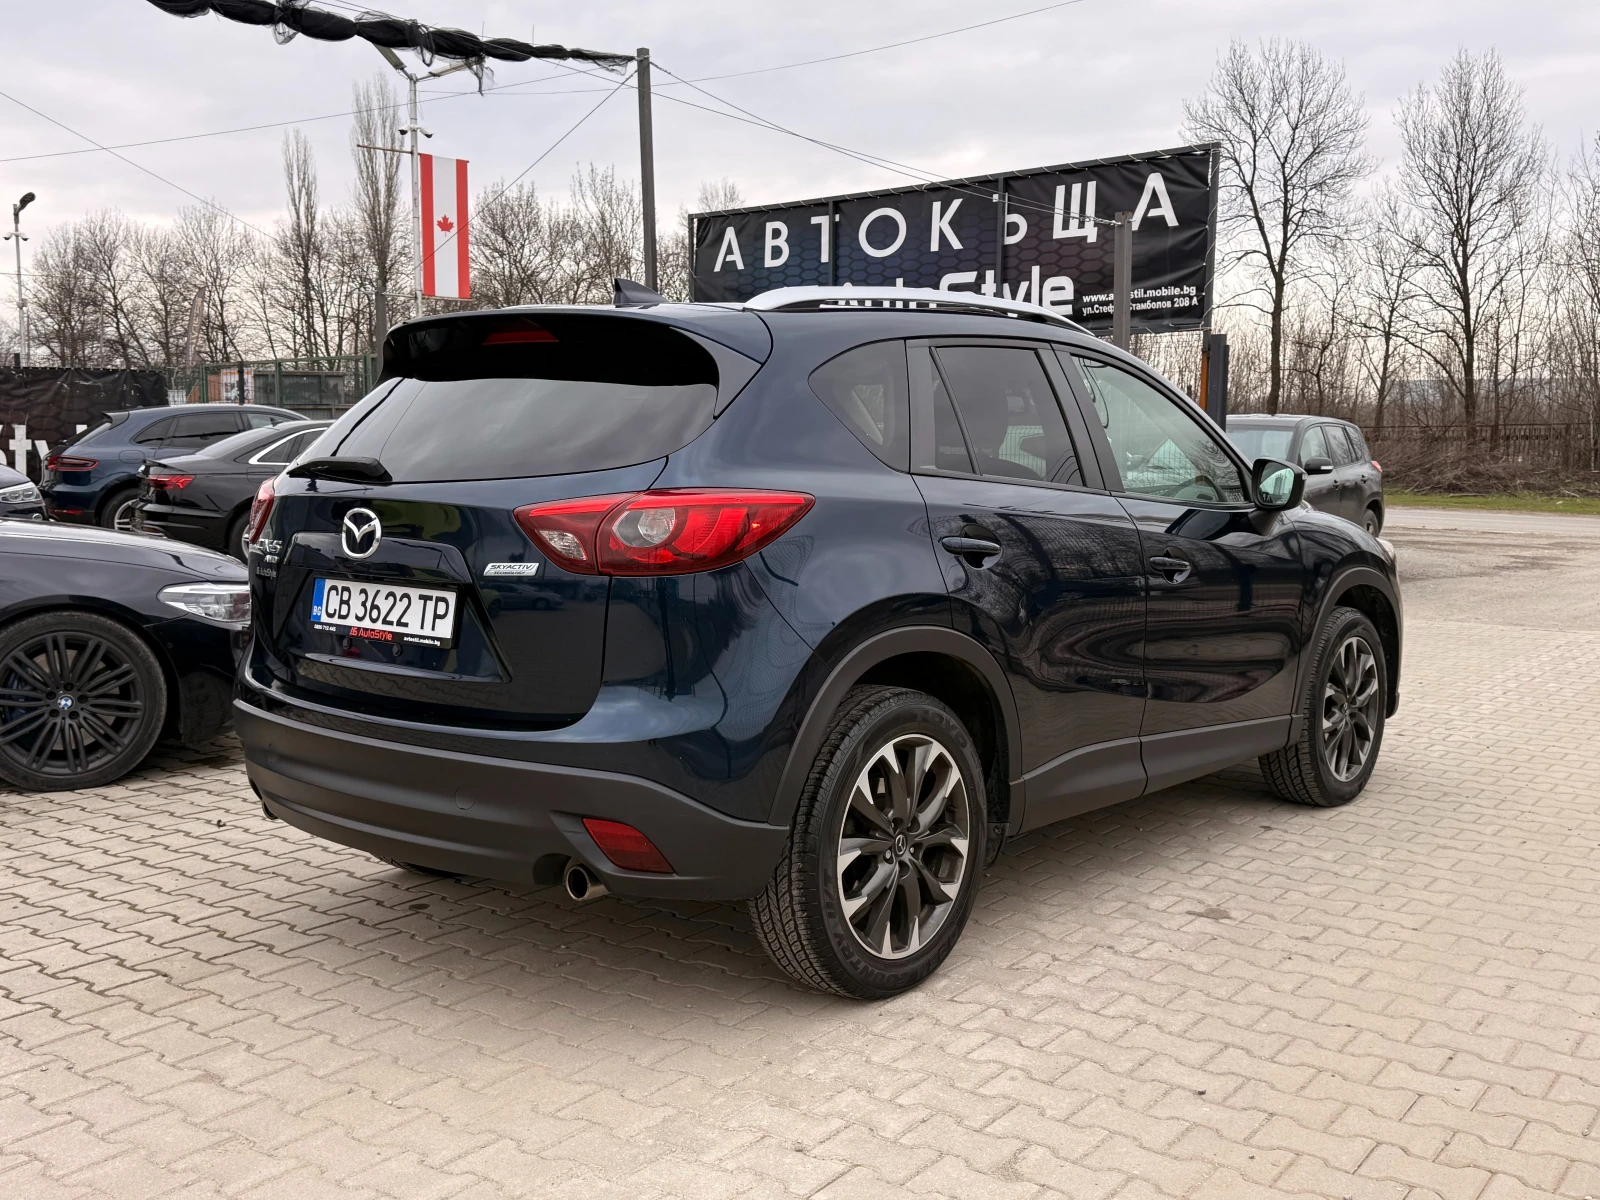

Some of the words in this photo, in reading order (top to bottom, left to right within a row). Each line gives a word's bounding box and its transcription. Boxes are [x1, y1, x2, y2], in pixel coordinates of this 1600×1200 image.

[1082, 285, 1197, 303] www.astil.mobile.bg
[1174, 297, 1190, 308] 208
[313, 605, 322, 616] BG
[325, 584, 352, 620] CB
[355, 587, 412, 628] 3622
[418, 593, 450, 632] TP
[358, 627, 393, 641] AutoStyle
